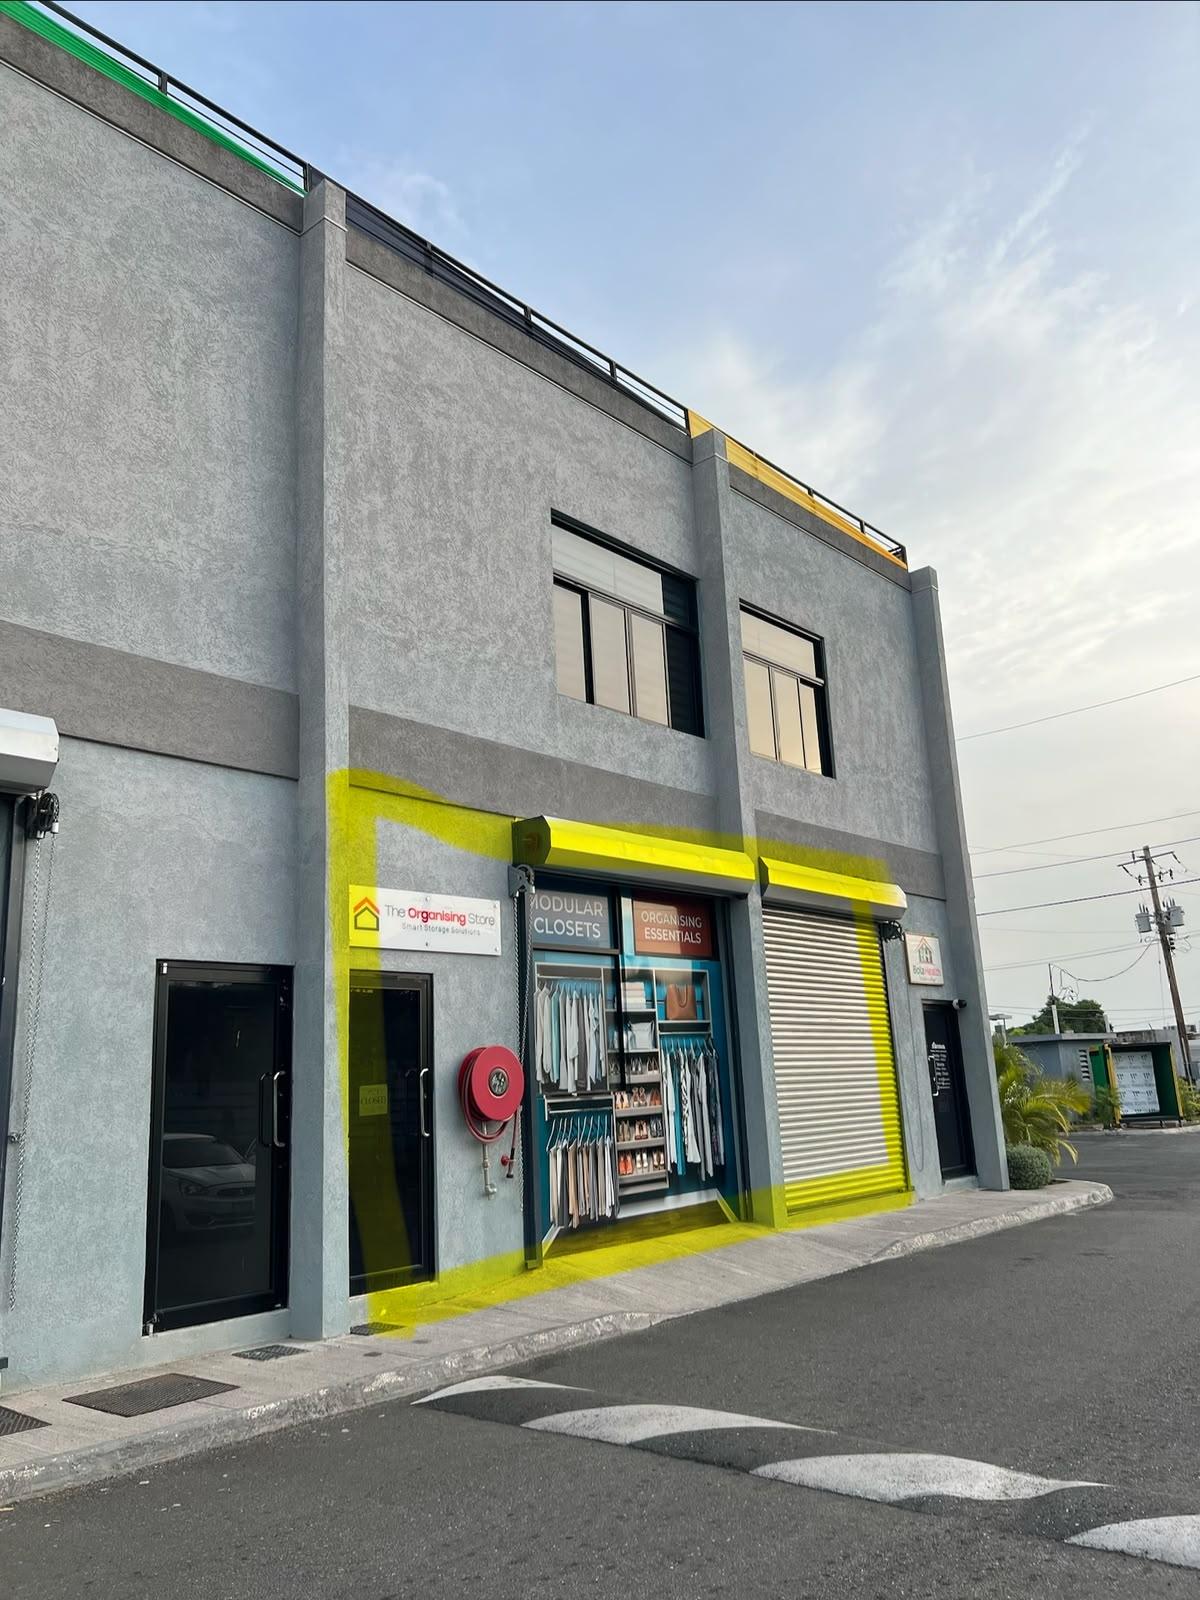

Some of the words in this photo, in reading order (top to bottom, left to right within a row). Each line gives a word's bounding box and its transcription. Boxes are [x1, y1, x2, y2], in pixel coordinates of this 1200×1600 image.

[384, 904, 405, 918] The
[407, 907, 466, 926] Organising
[468, 912, 495, 926] Store
[641, 910, 702, 928] ORGANISING
[402, 922, 423, 931] Smart
[424, 924, 450, 935] Storage
[451, 926, 481, 936] Solutions
[533, 916, 601, 938] CLOSETS
[644, 928, 702, 944] ESSENTIALS
